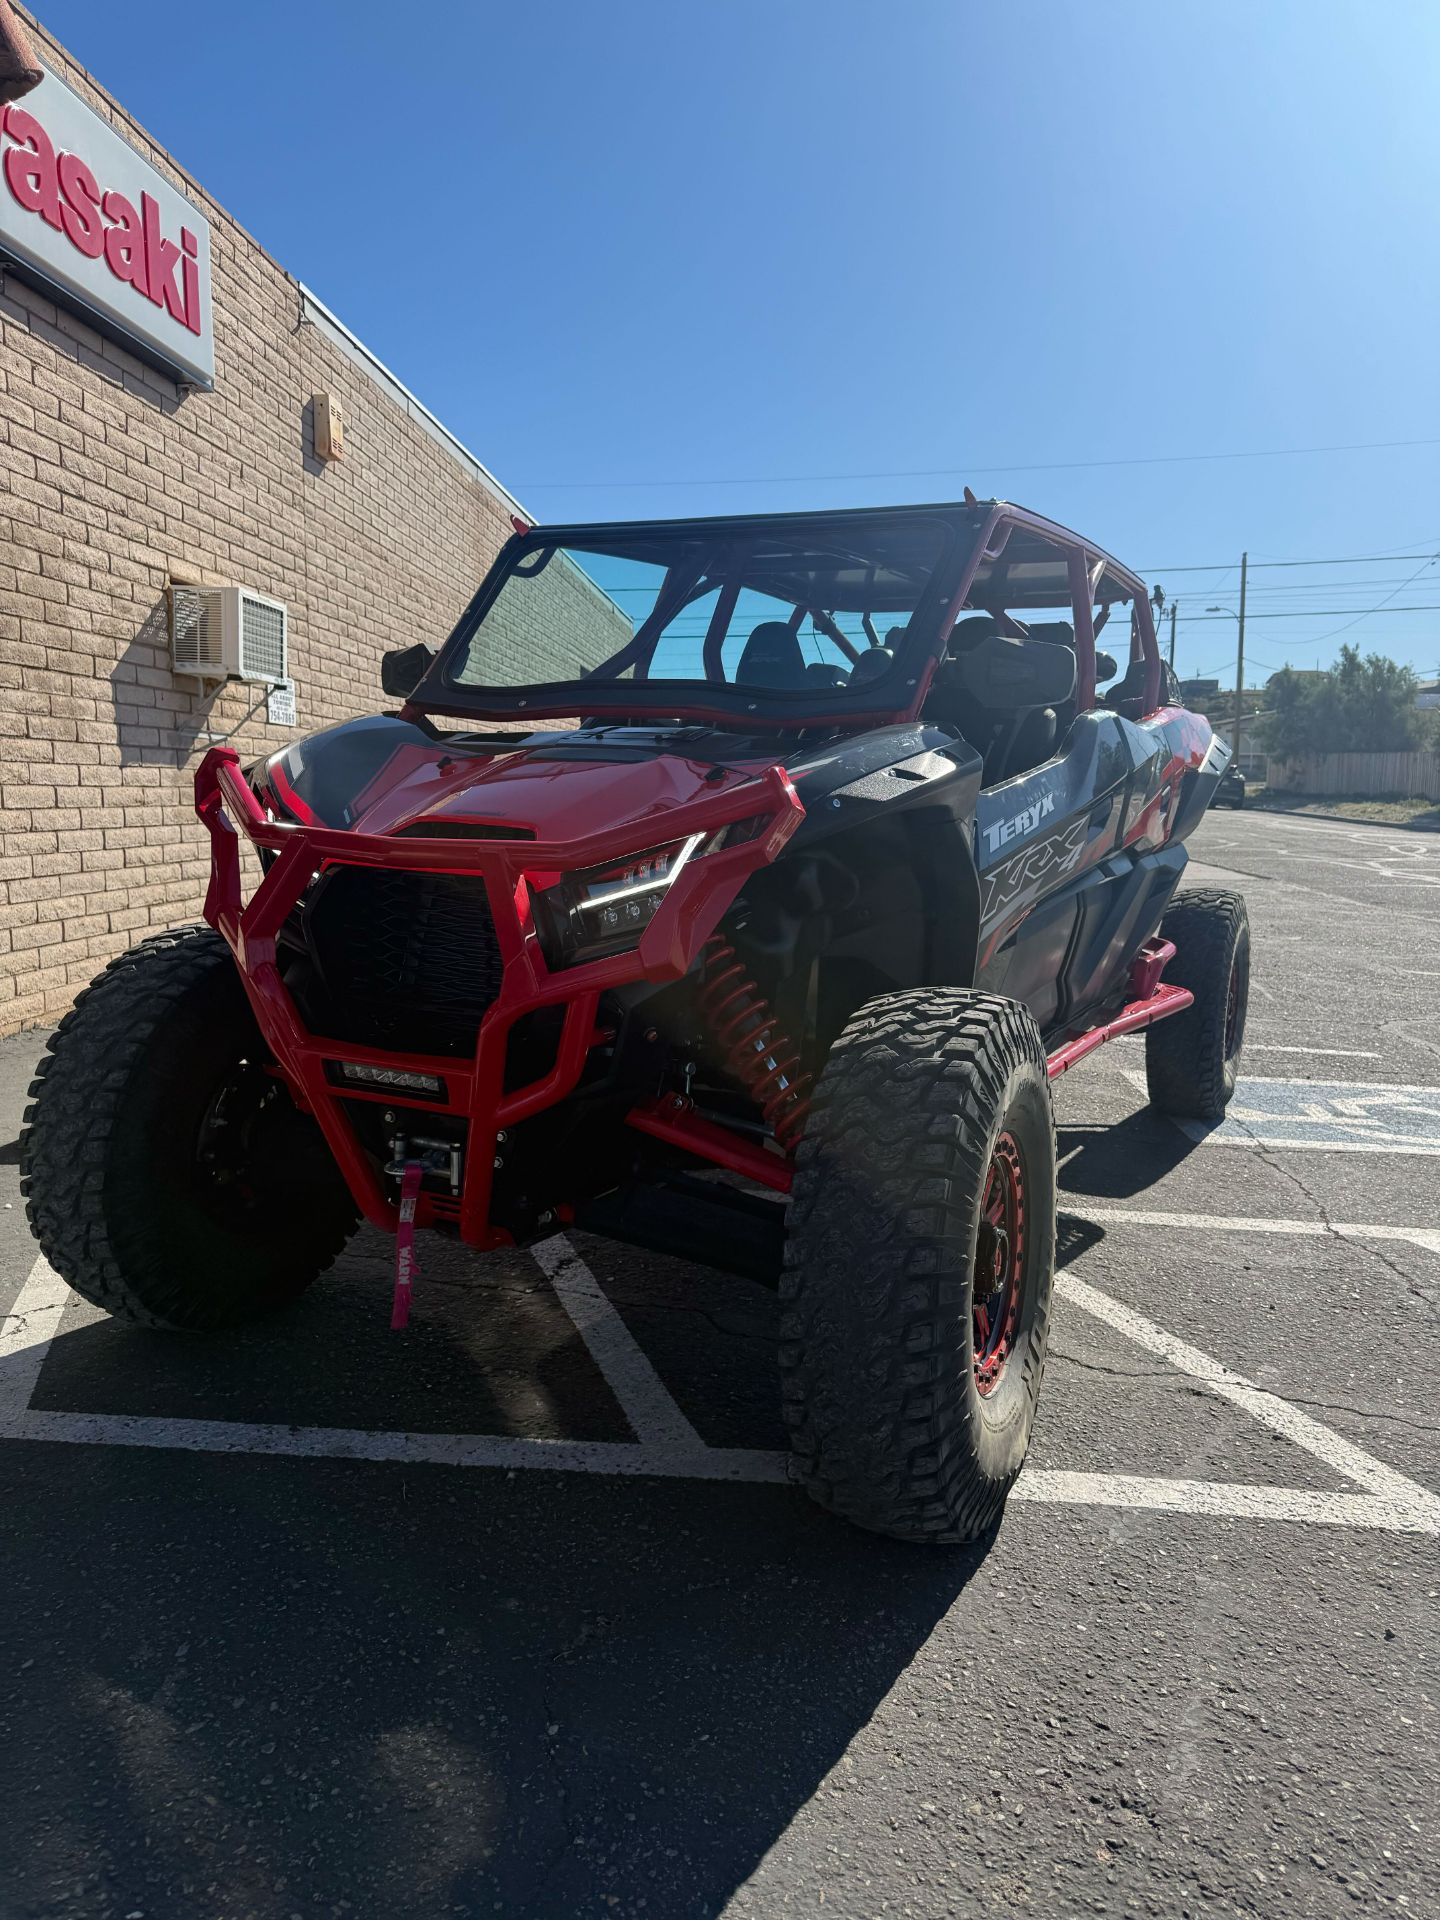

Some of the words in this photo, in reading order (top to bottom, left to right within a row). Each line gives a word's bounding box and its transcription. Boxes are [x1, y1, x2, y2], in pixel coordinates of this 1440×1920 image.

[0, 102, 201, 336] asaki
[983, 792, 1055, 853] TERYX
[399, 1245, 412, 1285] WARN
